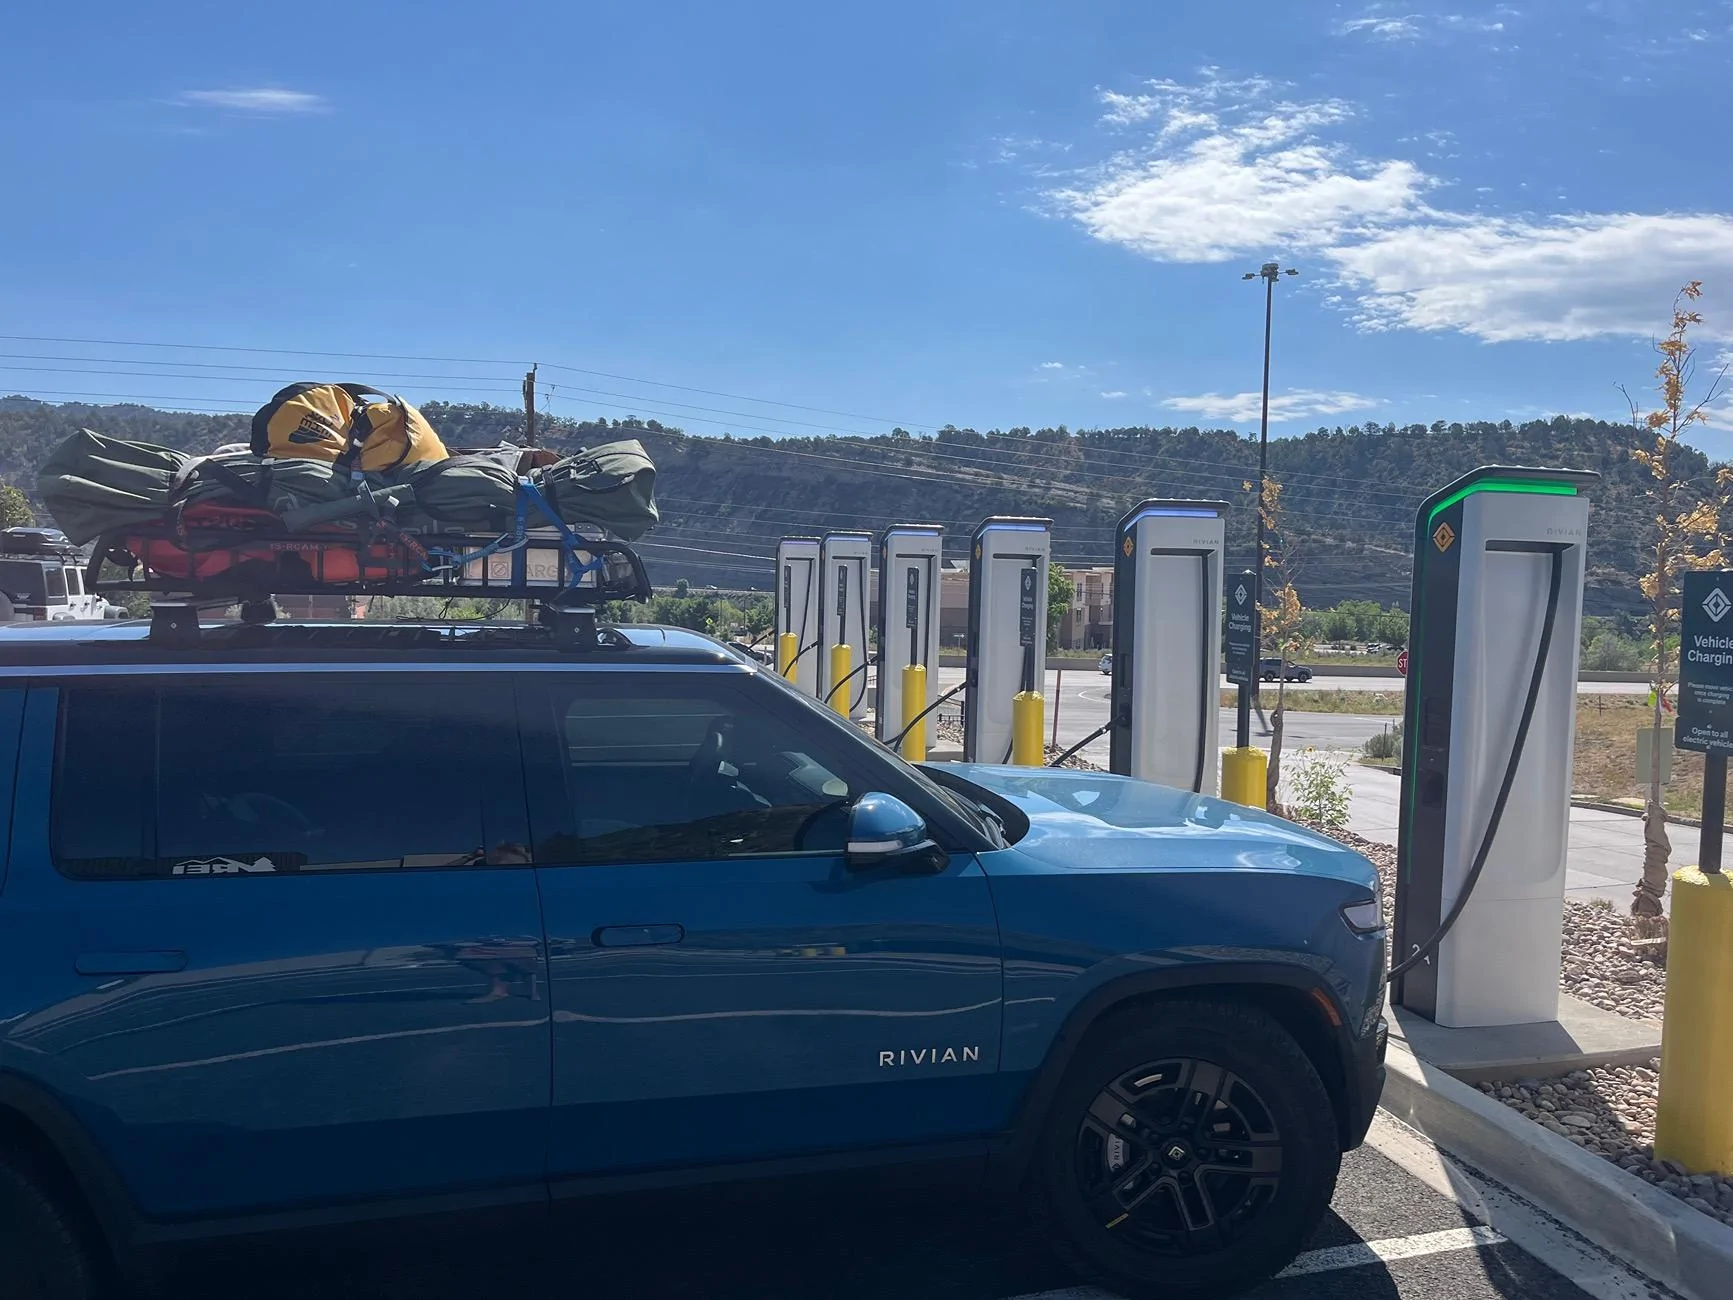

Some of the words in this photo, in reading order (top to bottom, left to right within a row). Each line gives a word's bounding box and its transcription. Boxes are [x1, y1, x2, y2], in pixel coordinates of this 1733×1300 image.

[1546, 526, 1581, 537] RIVIAN
[1228, 621, 1252, 632] Charging
[1398, 658, 1408, 668] ST
[1688, 650, 1733, 666] Chargin
[1692, 727, 1710, 737] Open
[1682, 736, 1709, 745] electric
[879, 1046, 979, 1067] RIVIAN
